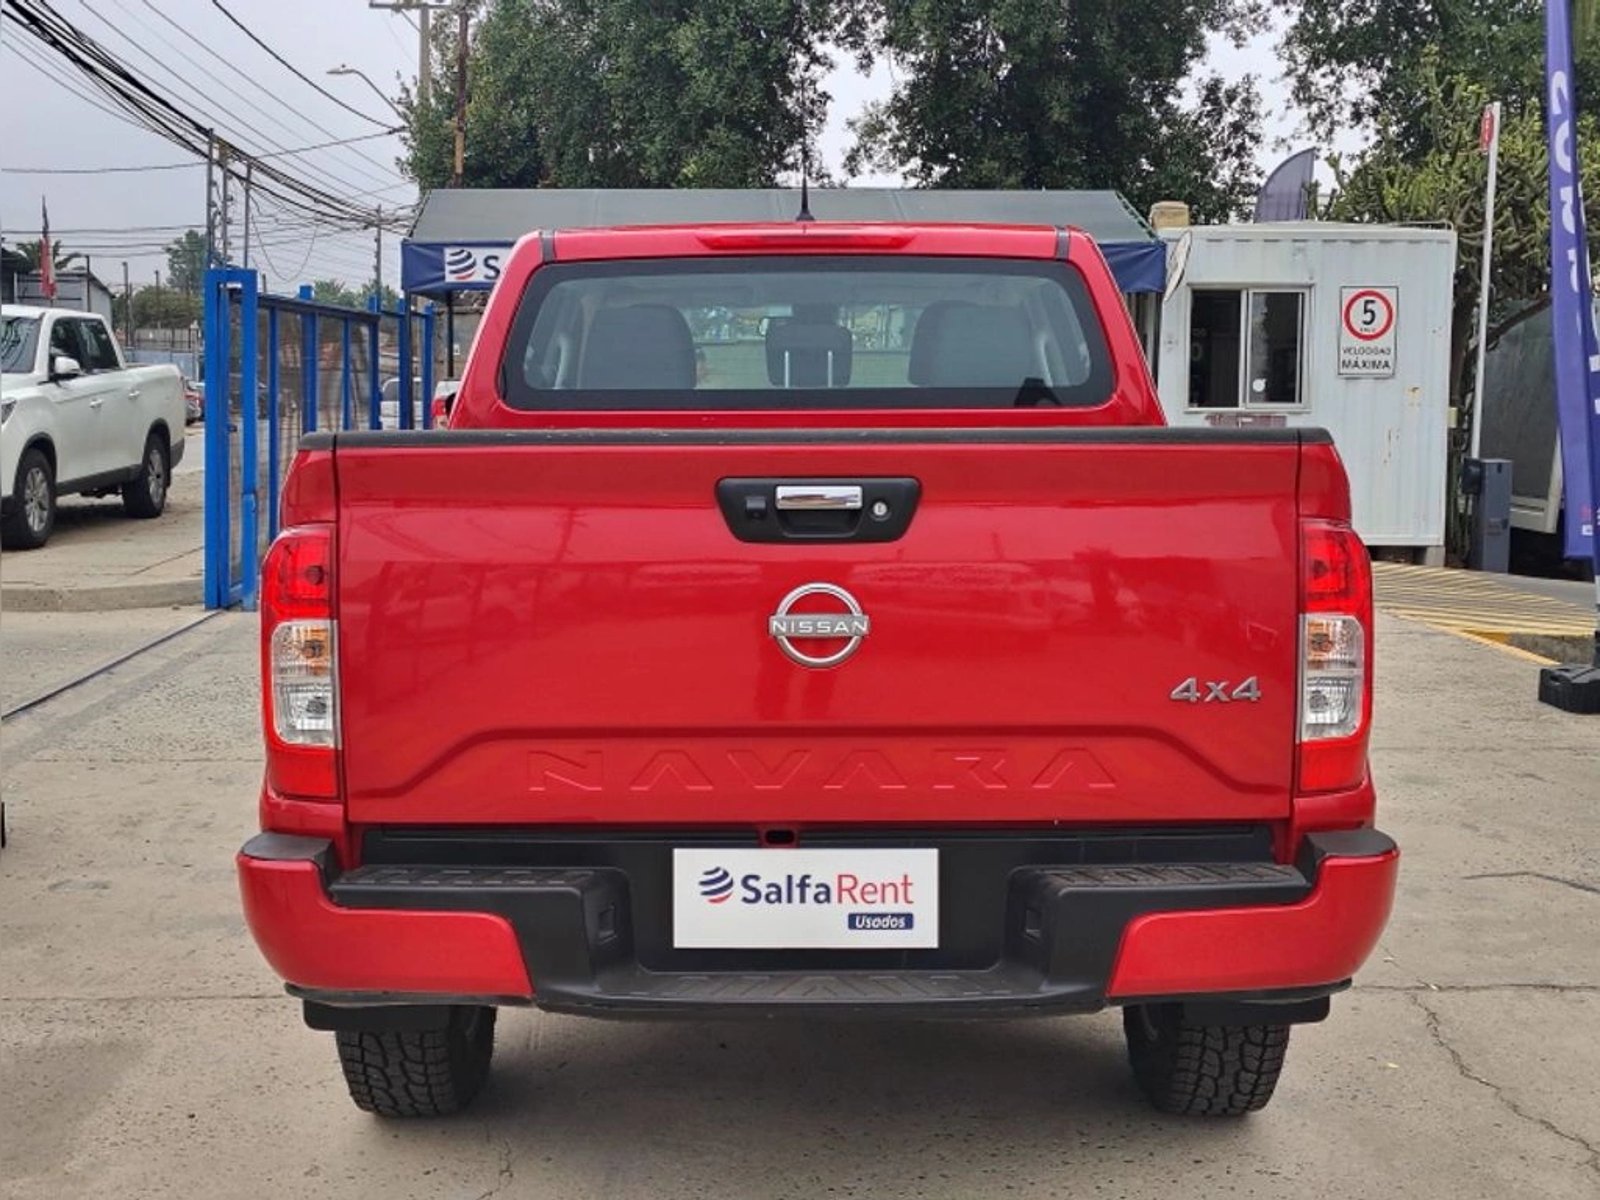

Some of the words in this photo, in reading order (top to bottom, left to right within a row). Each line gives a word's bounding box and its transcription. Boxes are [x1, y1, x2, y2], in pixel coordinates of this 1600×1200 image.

[1362, 299, 1376, 325] 5
[772, 620, 868, 634] NISSAN
[1170, 676, 1261, 702] 4x4
[527, 748, 1116, 792] NAVARA
[855, 915, 905, 930] Usados
